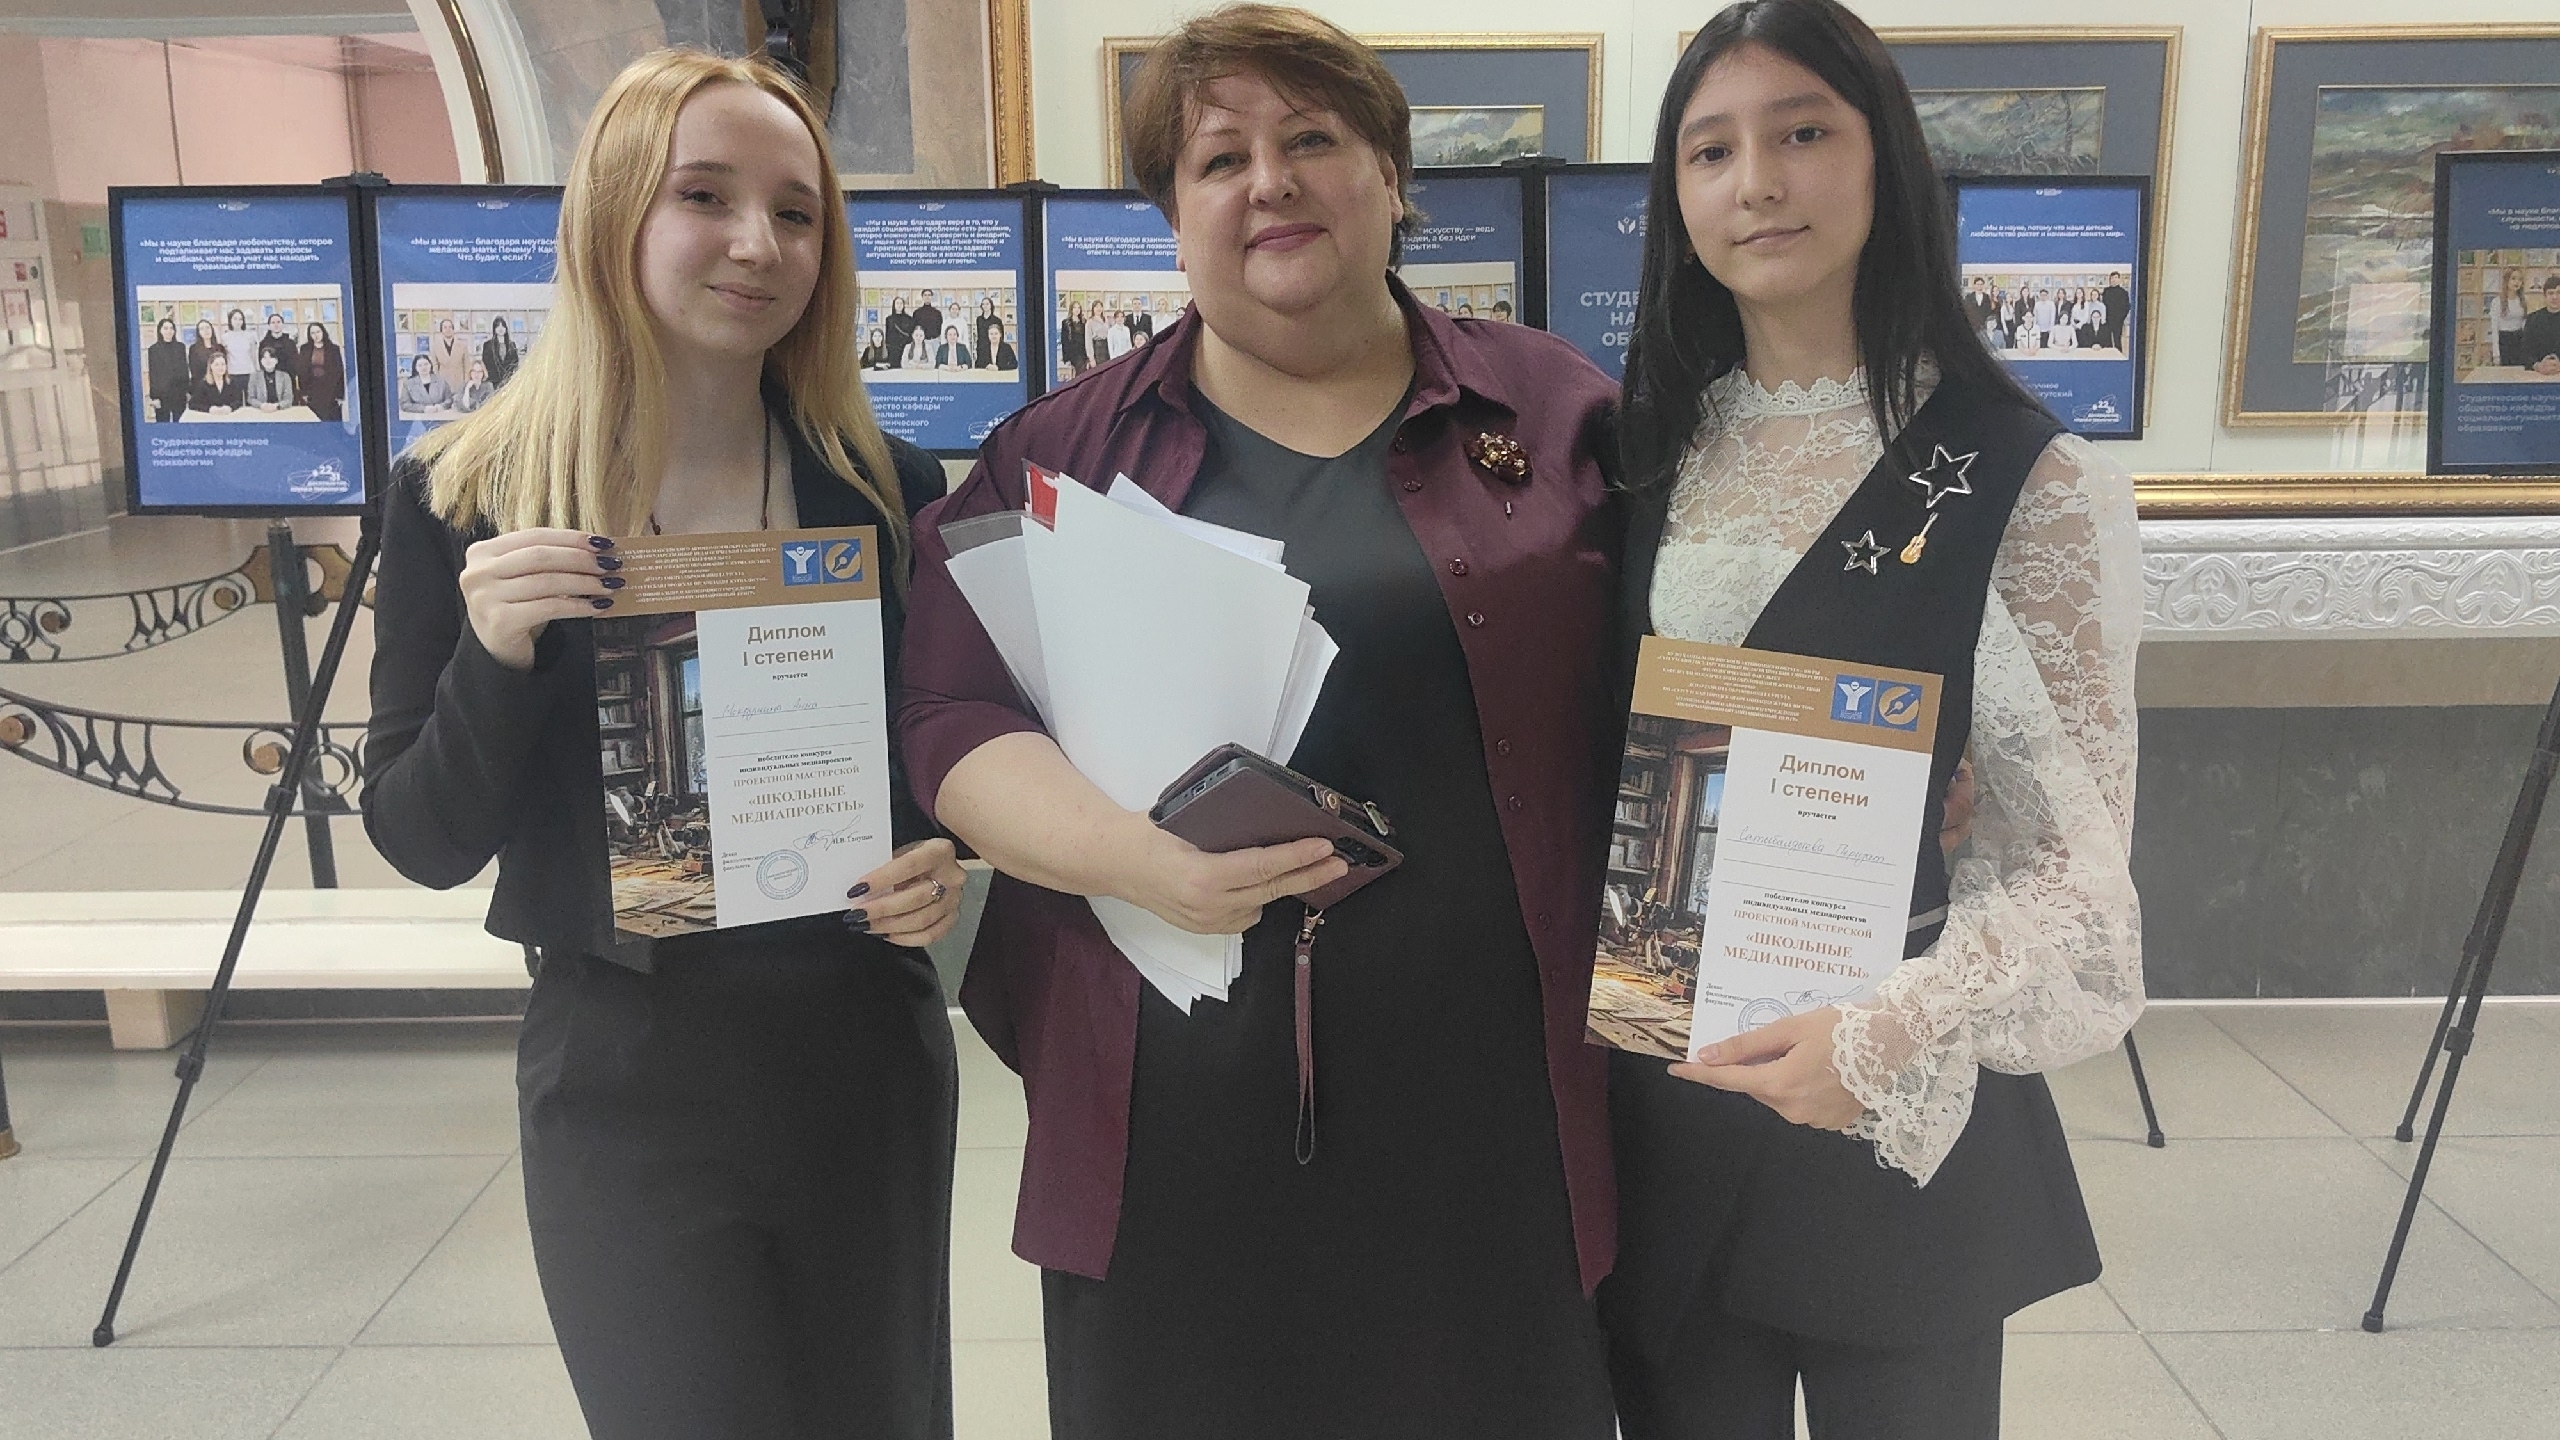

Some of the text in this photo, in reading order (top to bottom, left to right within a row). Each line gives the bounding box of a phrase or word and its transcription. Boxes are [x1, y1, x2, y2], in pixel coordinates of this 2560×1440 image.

[747, 624, 826, 644] Диплом
[754, 646, 834, 666] степени
[772, 672, 808, 681] вручается
[739, 756, 853, 773] индивидуальных медиапроектов
[757, 749, 832, 763] победителю конкурса
[733, 765, 860, 788] ПРОЕКТНОЙ МАСТЕРСКОЙ
[1779, 754, 1865, 781] Диплом
[748, 784, 846, 806] «ШКОЛЬНЫЕ
[1783, 784, 1869, 808] степени
[731, 800, 865, 826] МЕДИАПРОЕКТЫ»
[1798, 810, 1837, 820] вручается
[1743, 898, 1867, 924] индивидуальных медиапроектов
[1764, 892, 1846, 911] победителю конкурса
[1734, 909, 1873, 939] ПРОЕКТНОЙ МАСТЕРСКОЙ
[1746, 931, 1853, 958] «ШКОЛЬНЫЕ
[1723, 945, 1869, 980] МЕДИАПРОЕКТЫ»
